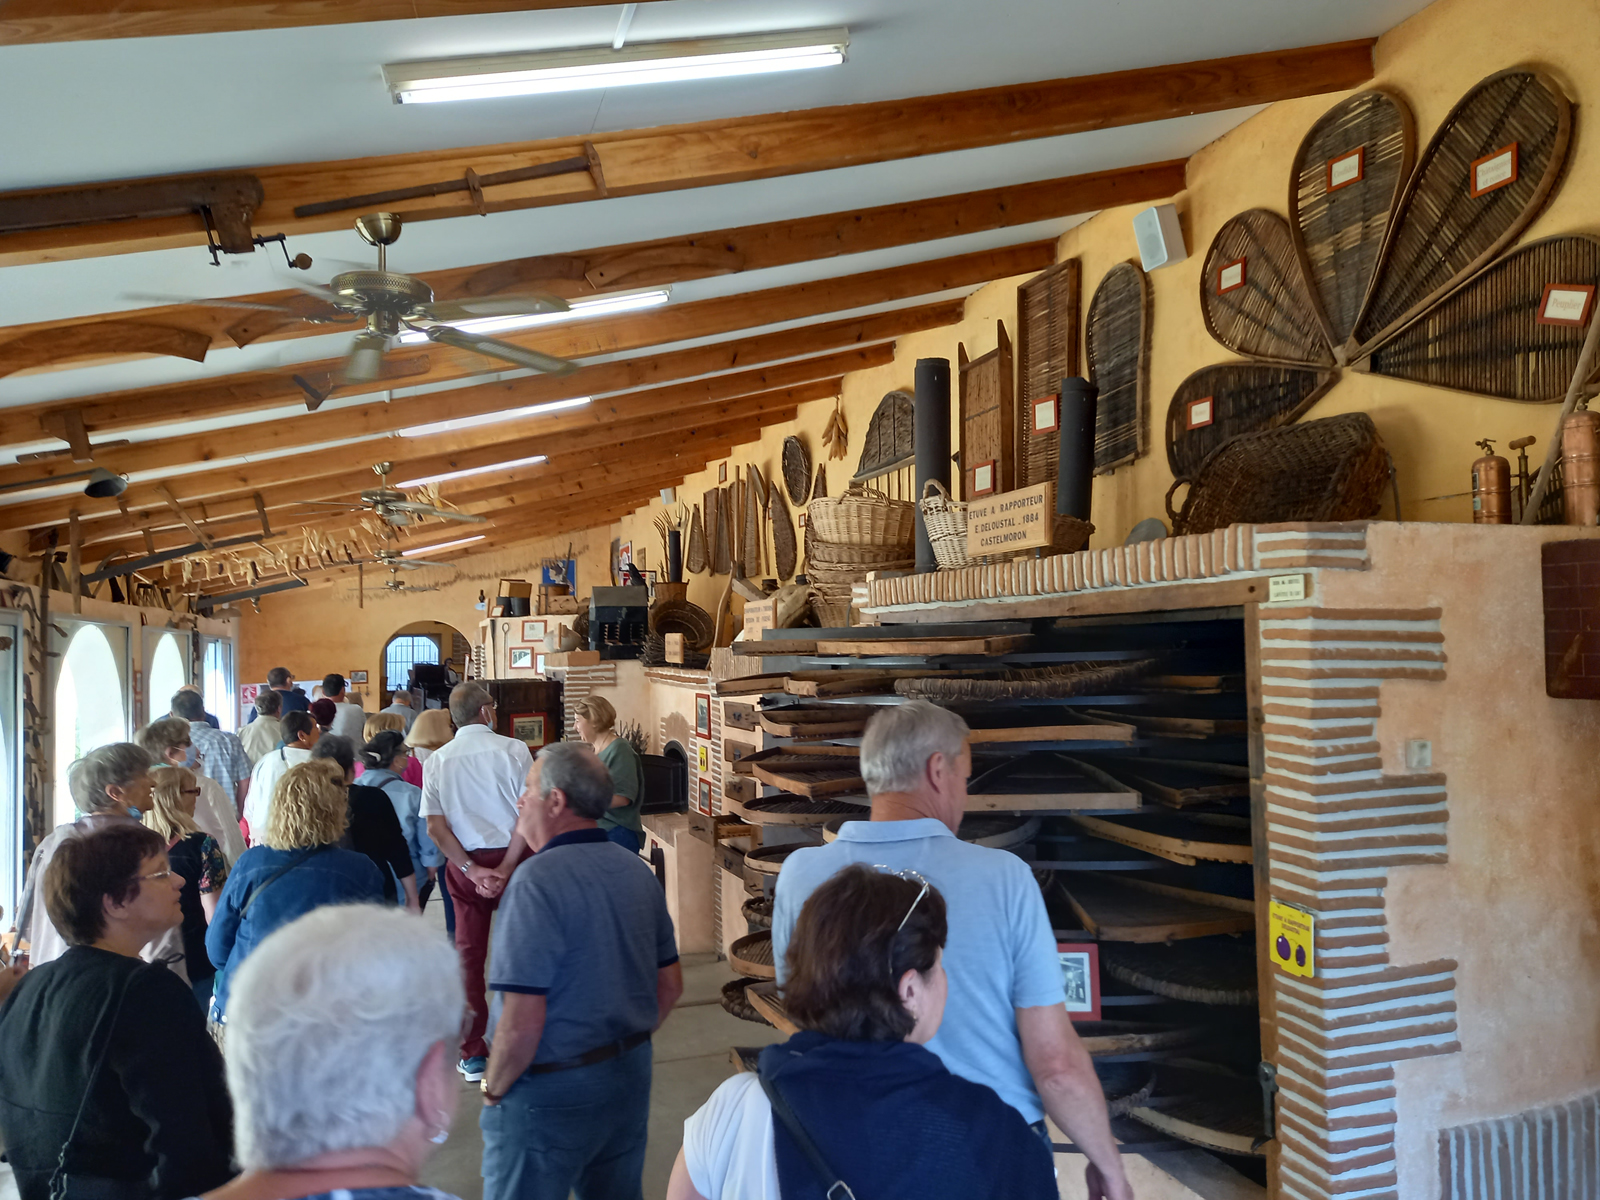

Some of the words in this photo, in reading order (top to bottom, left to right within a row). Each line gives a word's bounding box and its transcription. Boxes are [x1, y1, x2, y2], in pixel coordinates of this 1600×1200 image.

[1551, 297, 1581, 311] Peuplier
[969, 508, 987, 519] ETUVE
[991, 506, 996, 515] A
[1000, 495, 1043, 512] RAPPORTEUR
[1022, 512, 1039, 524] 1884
[980, 530, 1027, 547] CASTELMORON
